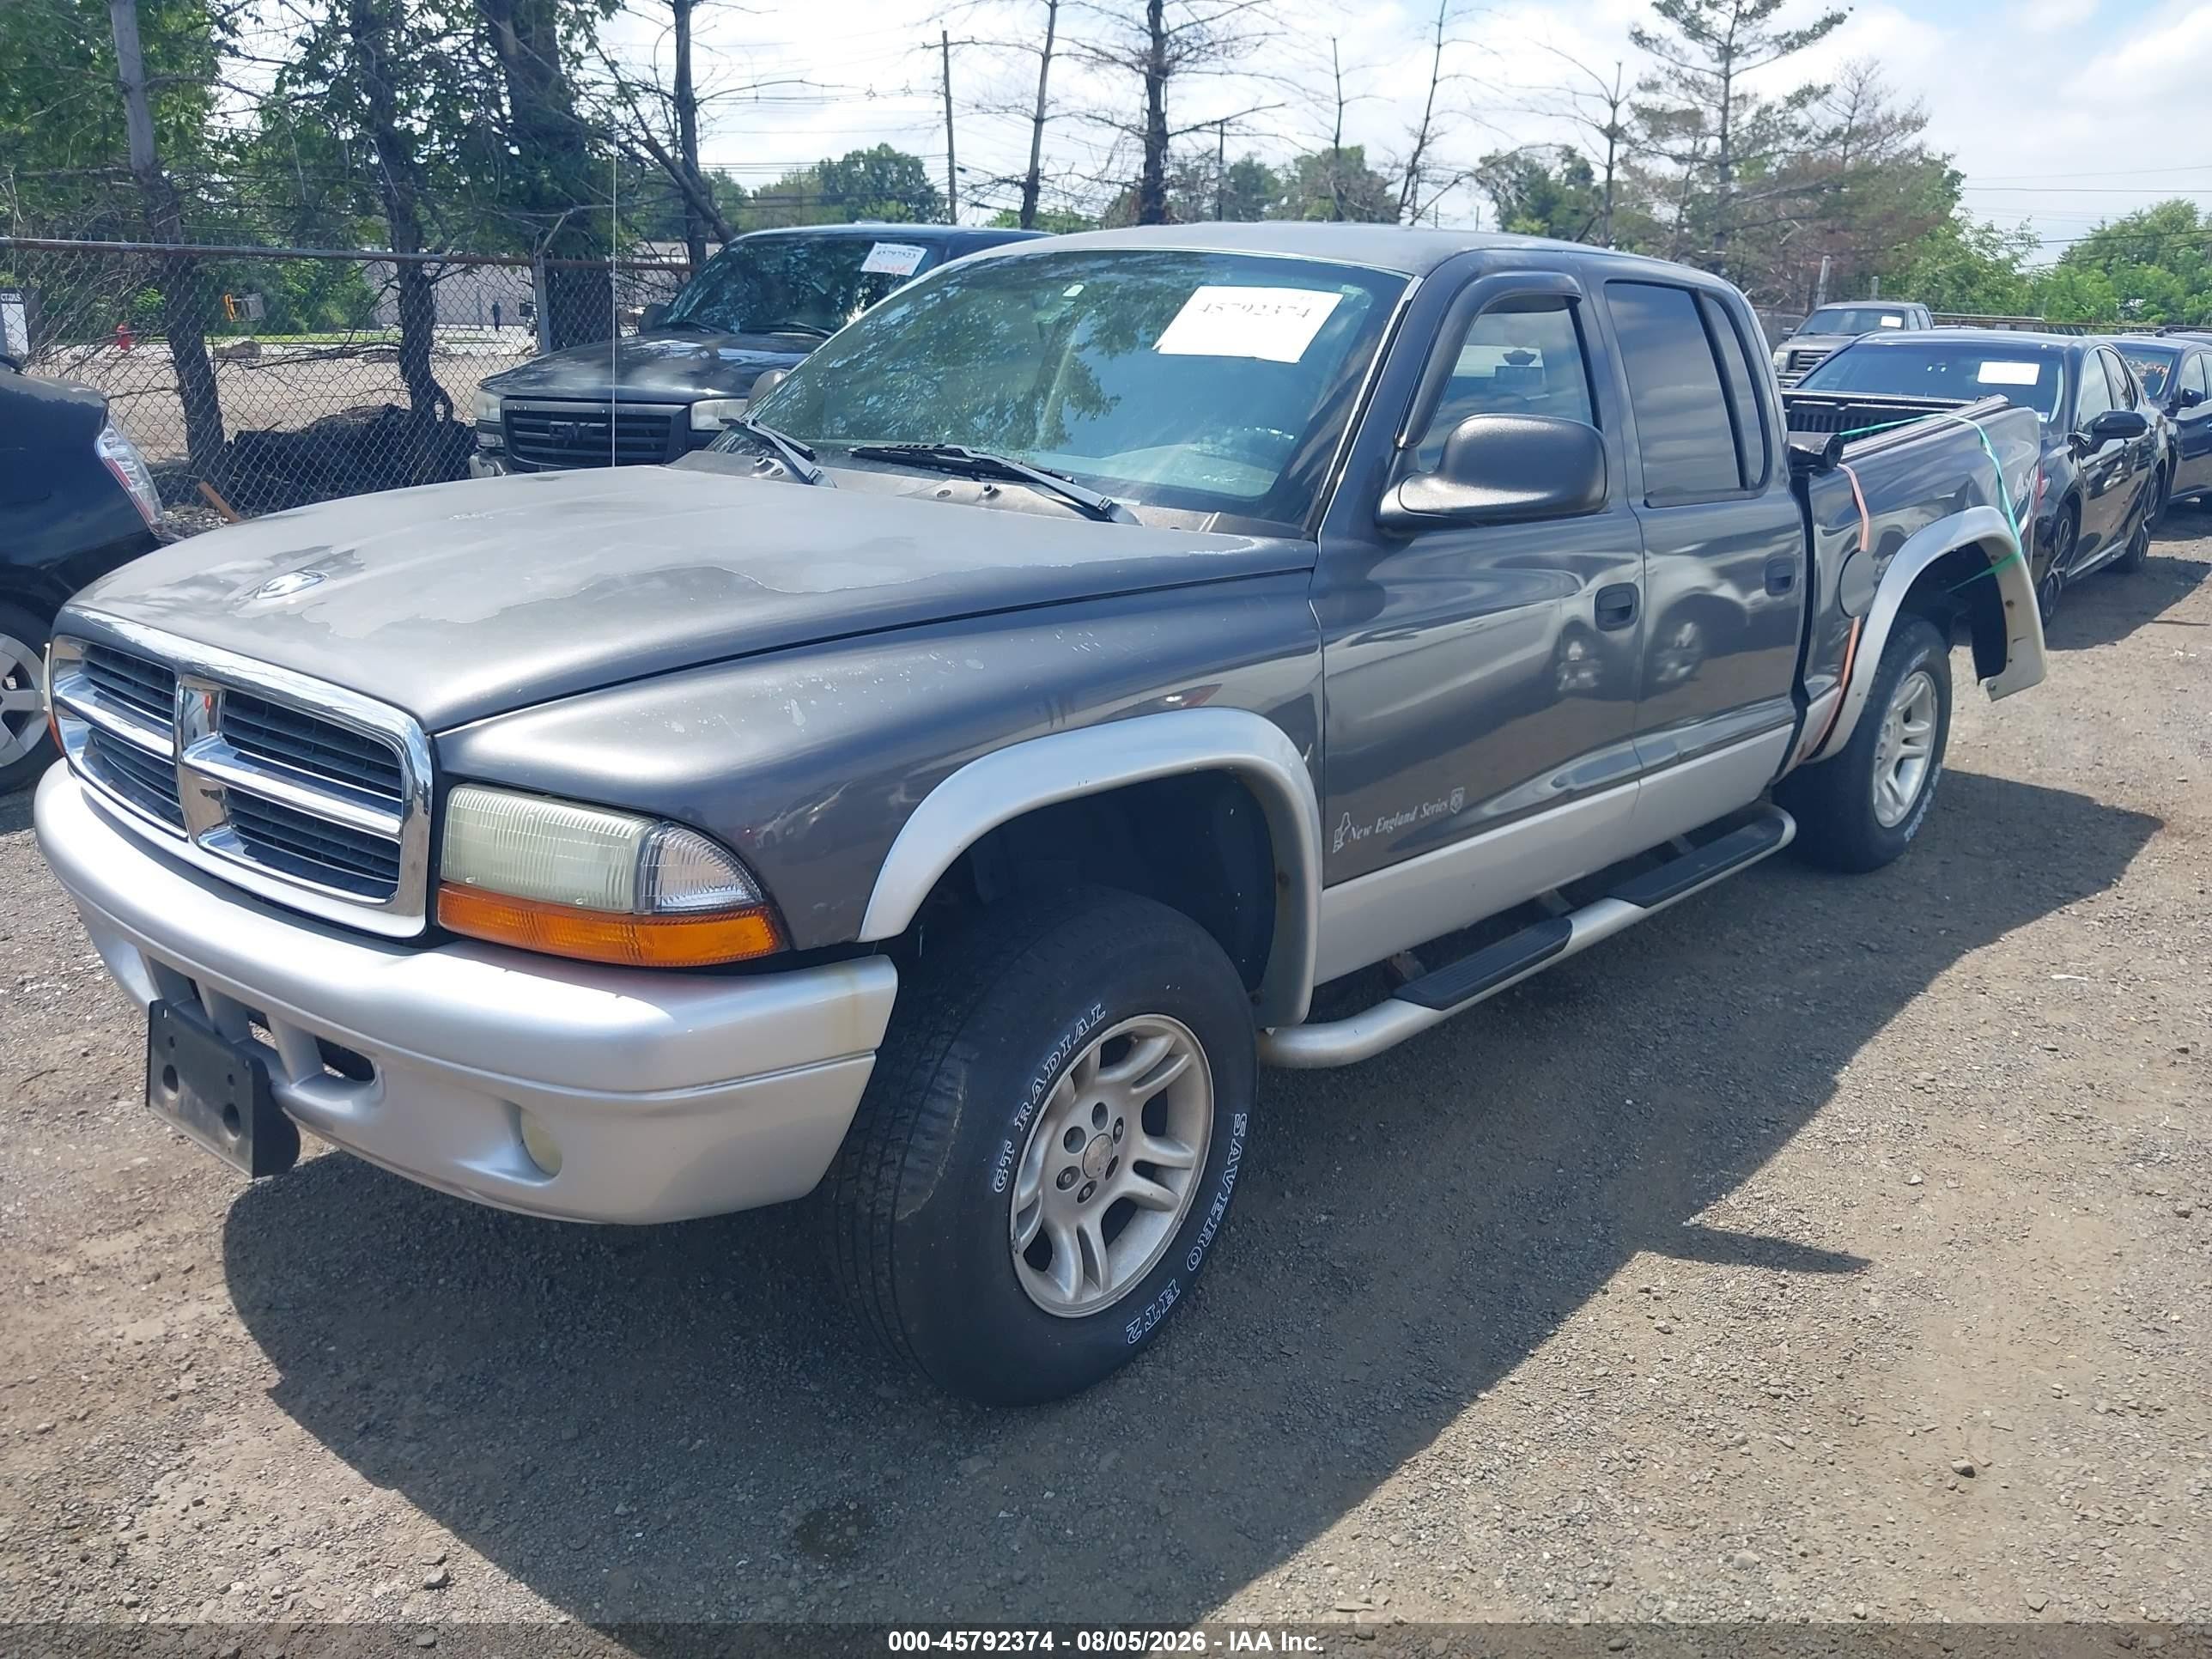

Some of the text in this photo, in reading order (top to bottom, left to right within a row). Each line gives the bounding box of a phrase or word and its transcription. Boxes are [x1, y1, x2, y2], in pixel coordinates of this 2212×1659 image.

[1348, 799, 1449, 842] New England Series
[993, 1003, 1106, 1194] GT RADIAL
[1126, 1113, 1248, 1345] SAVERO HT2
